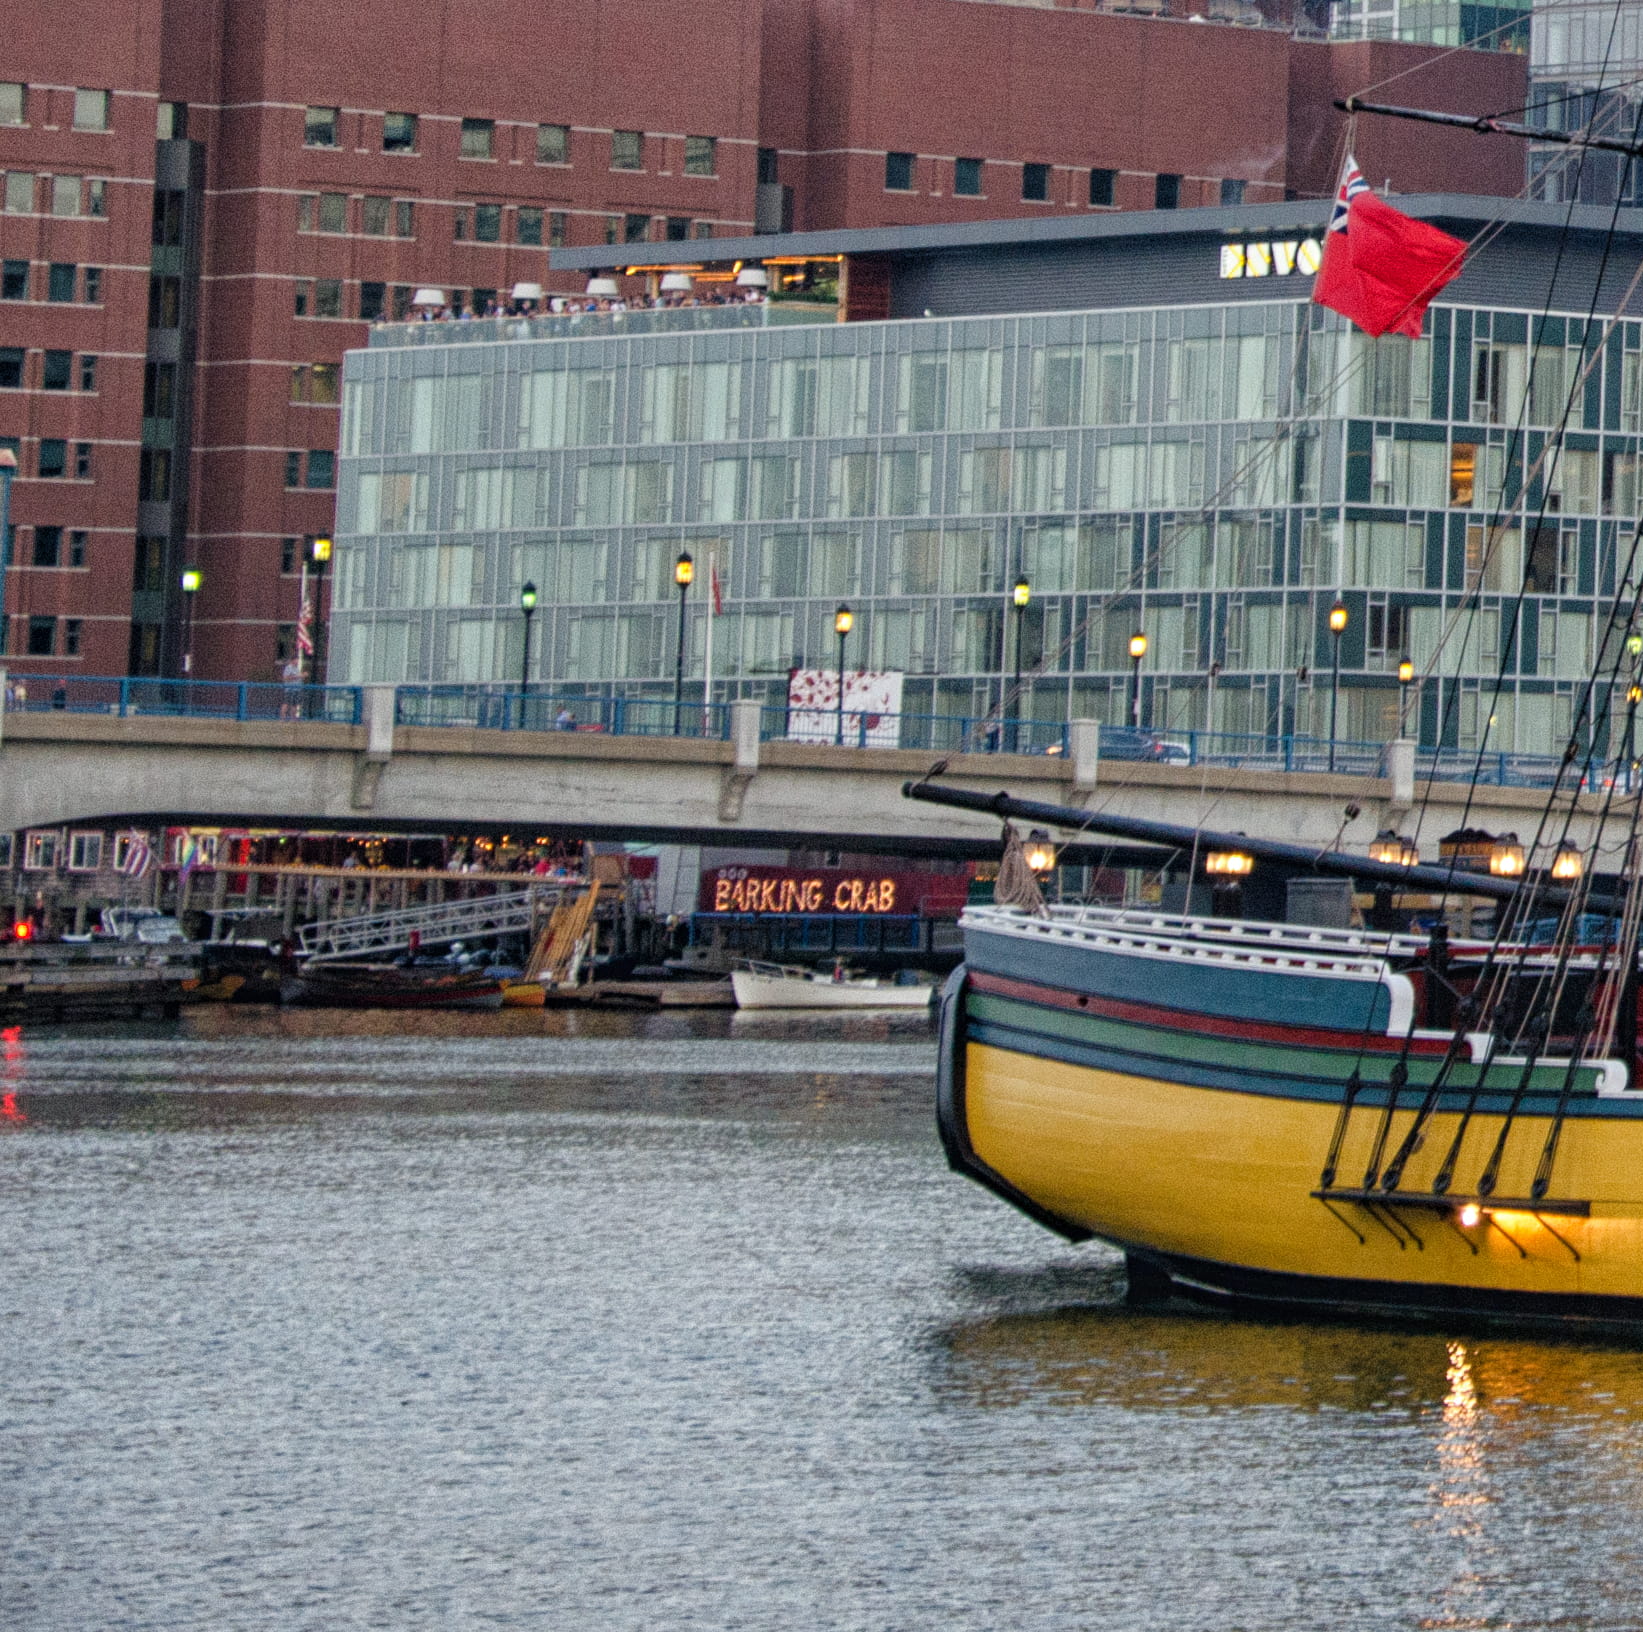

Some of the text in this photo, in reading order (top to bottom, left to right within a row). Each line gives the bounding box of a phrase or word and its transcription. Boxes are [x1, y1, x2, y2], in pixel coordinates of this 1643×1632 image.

[1220, 238, 1324, 278] ENVO
[715, 878, 896, 912] BARKING CRAB
